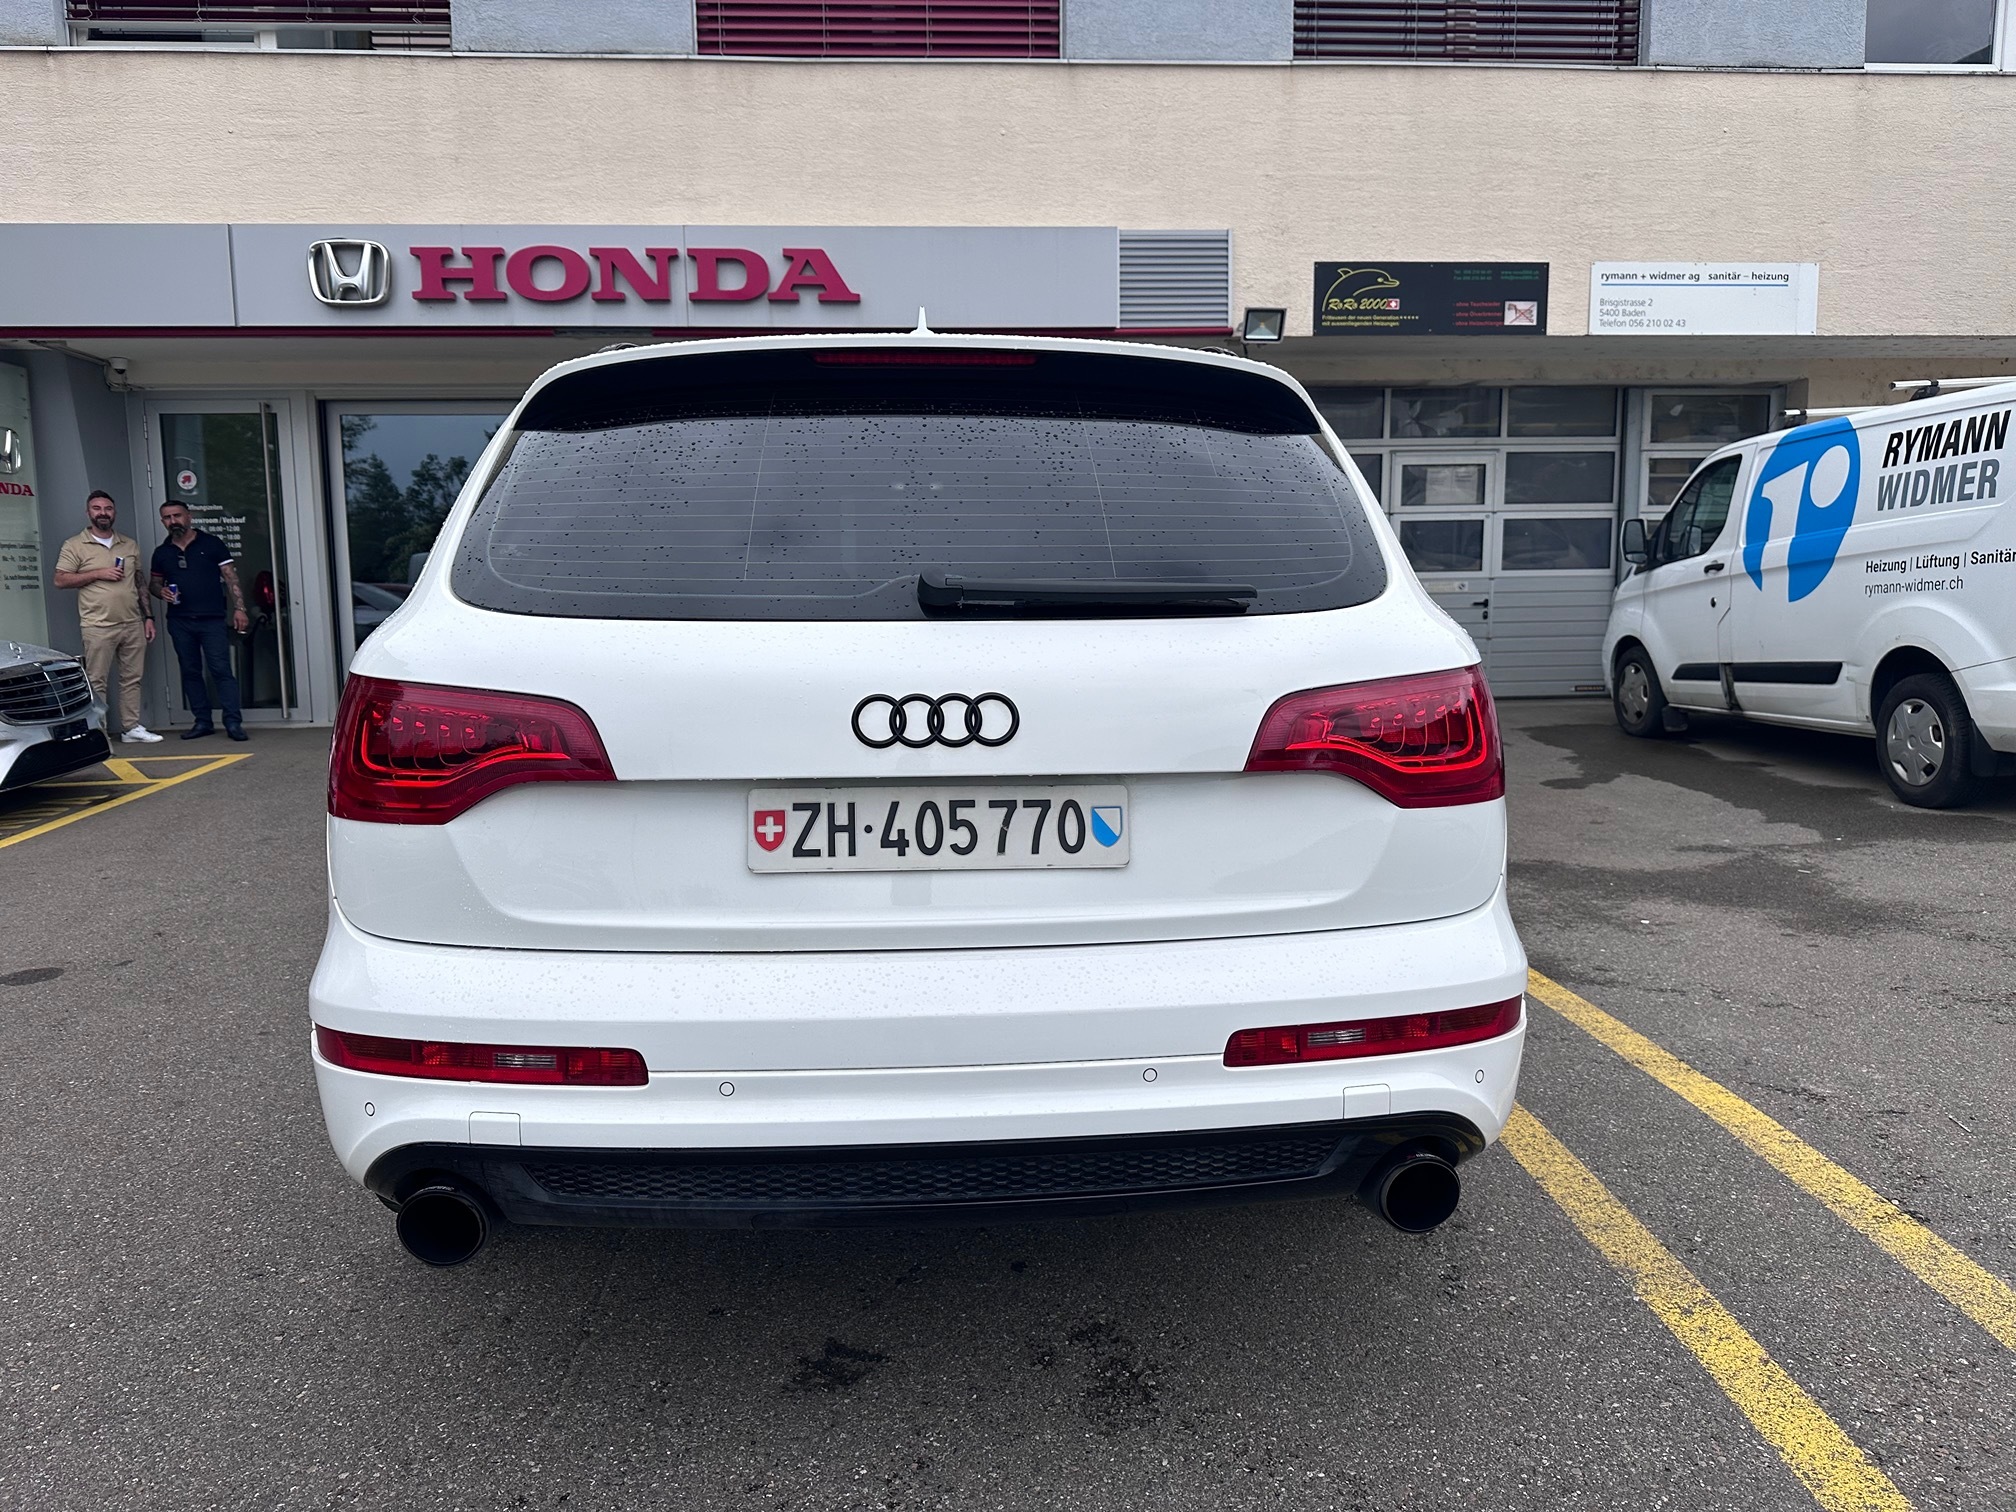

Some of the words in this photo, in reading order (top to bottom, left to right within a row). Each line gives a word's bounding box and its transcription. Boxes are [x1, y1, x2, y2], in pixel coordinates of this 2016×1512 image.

[409, 245, 861, 304] HONDA
[1601, 272, 1638, 281] rymann
[1649, 271, 1686, 280] widmer
[1688, 273, 1700, 282] ag
[1708, 271, 1741, 280] sanitär
[1751, 272, 1789, 282] heizung
[1359, 298, 1388, 310] 2000
[1600, 298, 1646, 308] Brisgistrasse
[1648, 298, 1653, 306] 2
[1600, 309, 1619, 317] 5400
[1622, 309, 1646, 317] Baden
[1600, 319, 1626, 327] Telefon
[1629, 319, 1644, 327] 056
[1646, 319, 1661, 327] 210
[1663, 319, 1673, 327] 02
[1675, 319, 1686, 327] 43
[1882, 409, 2012, 469] RYMANN
[1877, 458, 2001, 512] WIDMER
[1865, 559, 1907, 574] Heizung
[1915, 554, 1960, 570] Lüftung
[1970, 548, 2016, 565] Sanitär
[1865, 575, 1964, 598] rymann-widmer.ch
